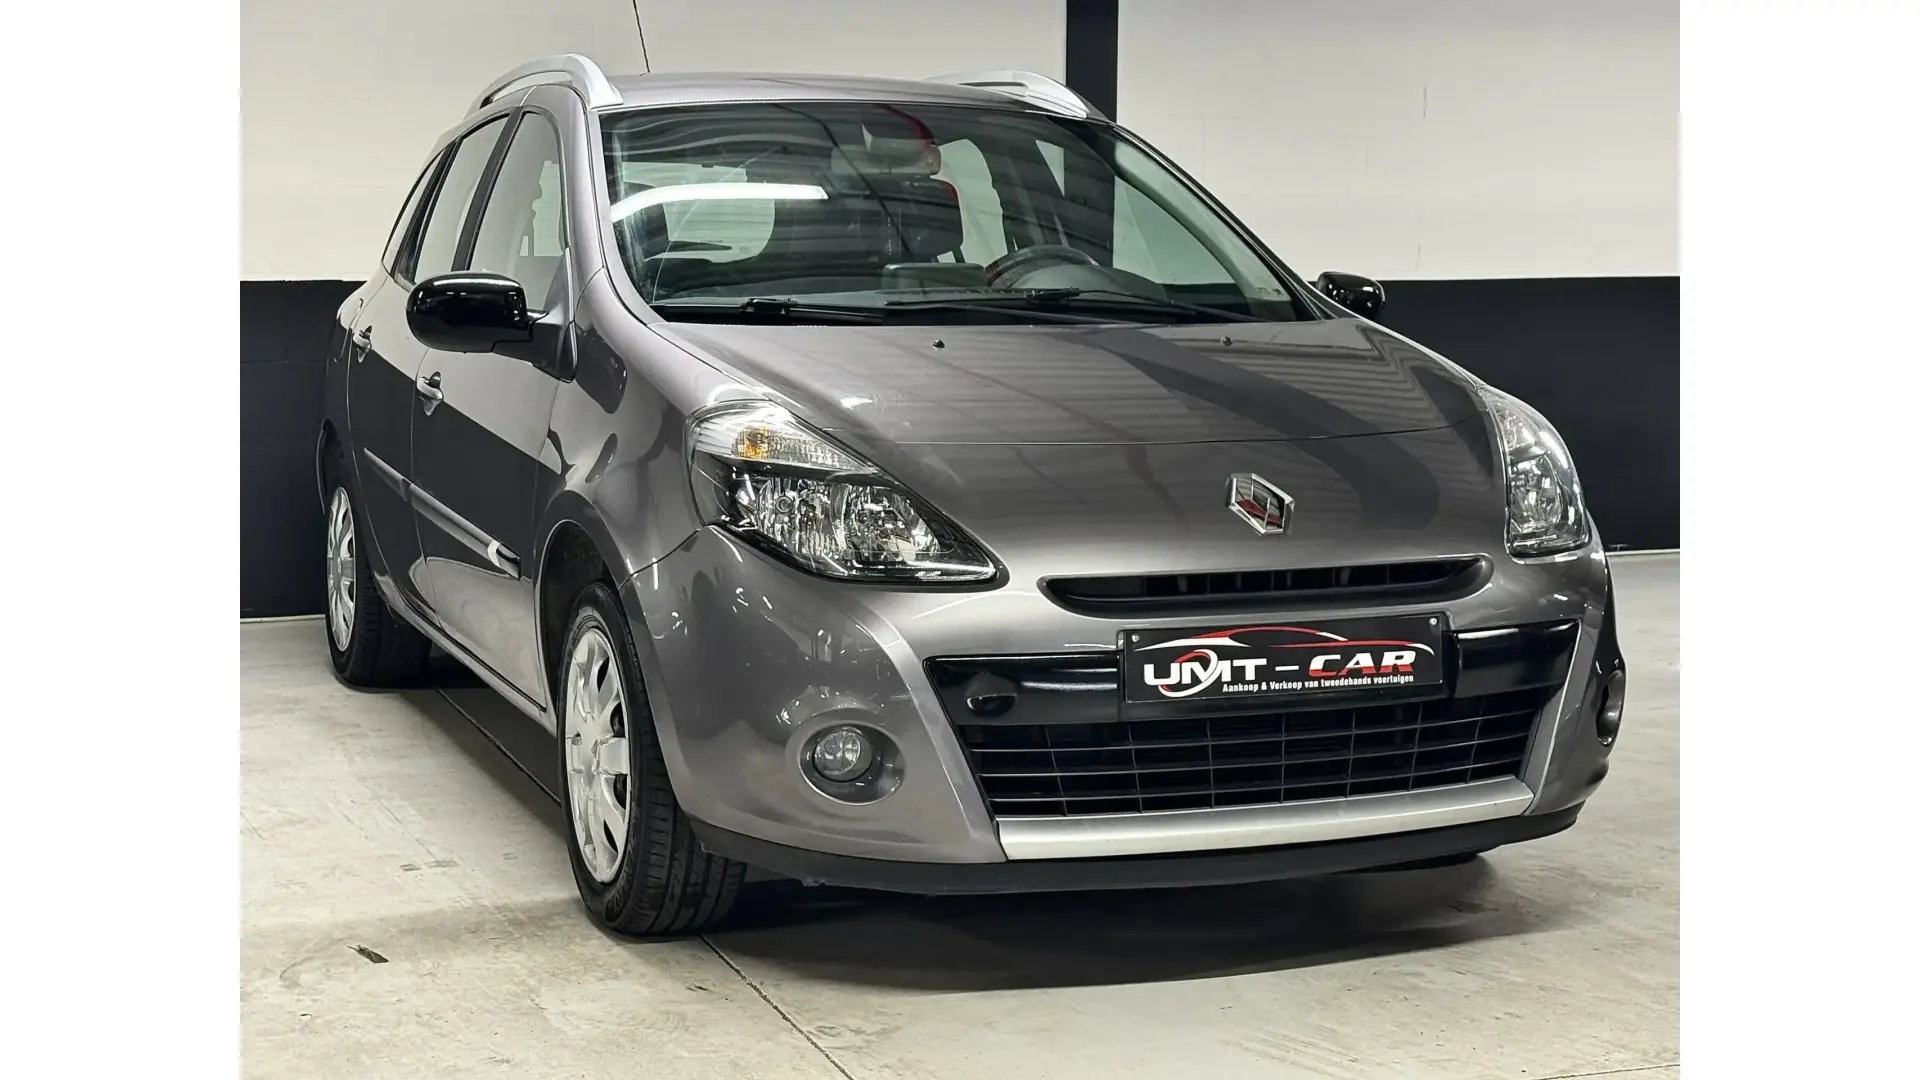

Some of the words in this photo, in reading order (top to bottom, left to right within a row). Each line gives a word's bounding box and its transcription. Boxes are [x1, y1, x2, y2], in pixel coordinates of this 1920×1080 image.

[1143, 658, 1267, 686] UMT
[1308, 650, 1417, 677] CAR
[1222, 682, 1259, 693] Aankoop
[1261, 681, 1268, 690] &
[1269, 680, 1303, 690] Verkoop
[1304, 680, 1319, 688] van
[1320, 676, 1372, 687] tweedehands
[1373, 674, 1414, 685] voertuigen
